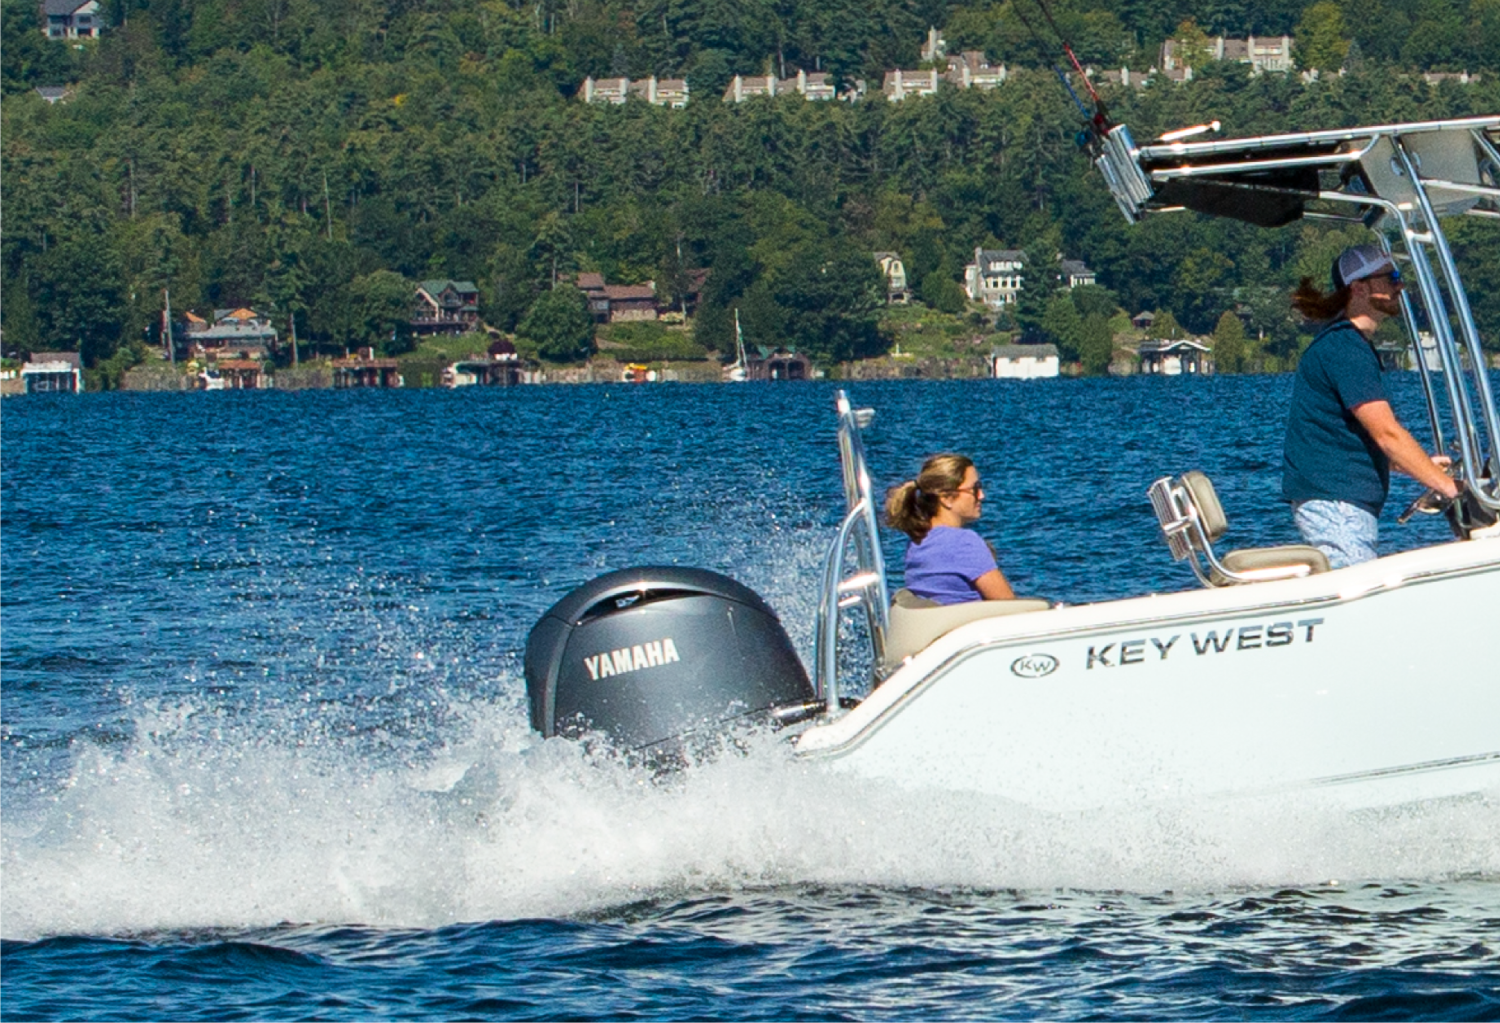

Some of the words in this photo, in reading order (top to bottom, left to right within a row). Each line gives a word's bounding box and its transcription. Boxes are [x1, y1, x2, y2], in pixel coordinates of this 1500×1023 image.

[583, 637, 680, 681] YAMAHA
[1020, 659, 1051, 673] KW
[1086, 634, 1181, 670] KEY
[1190, 618, 1324, 656] WEST
